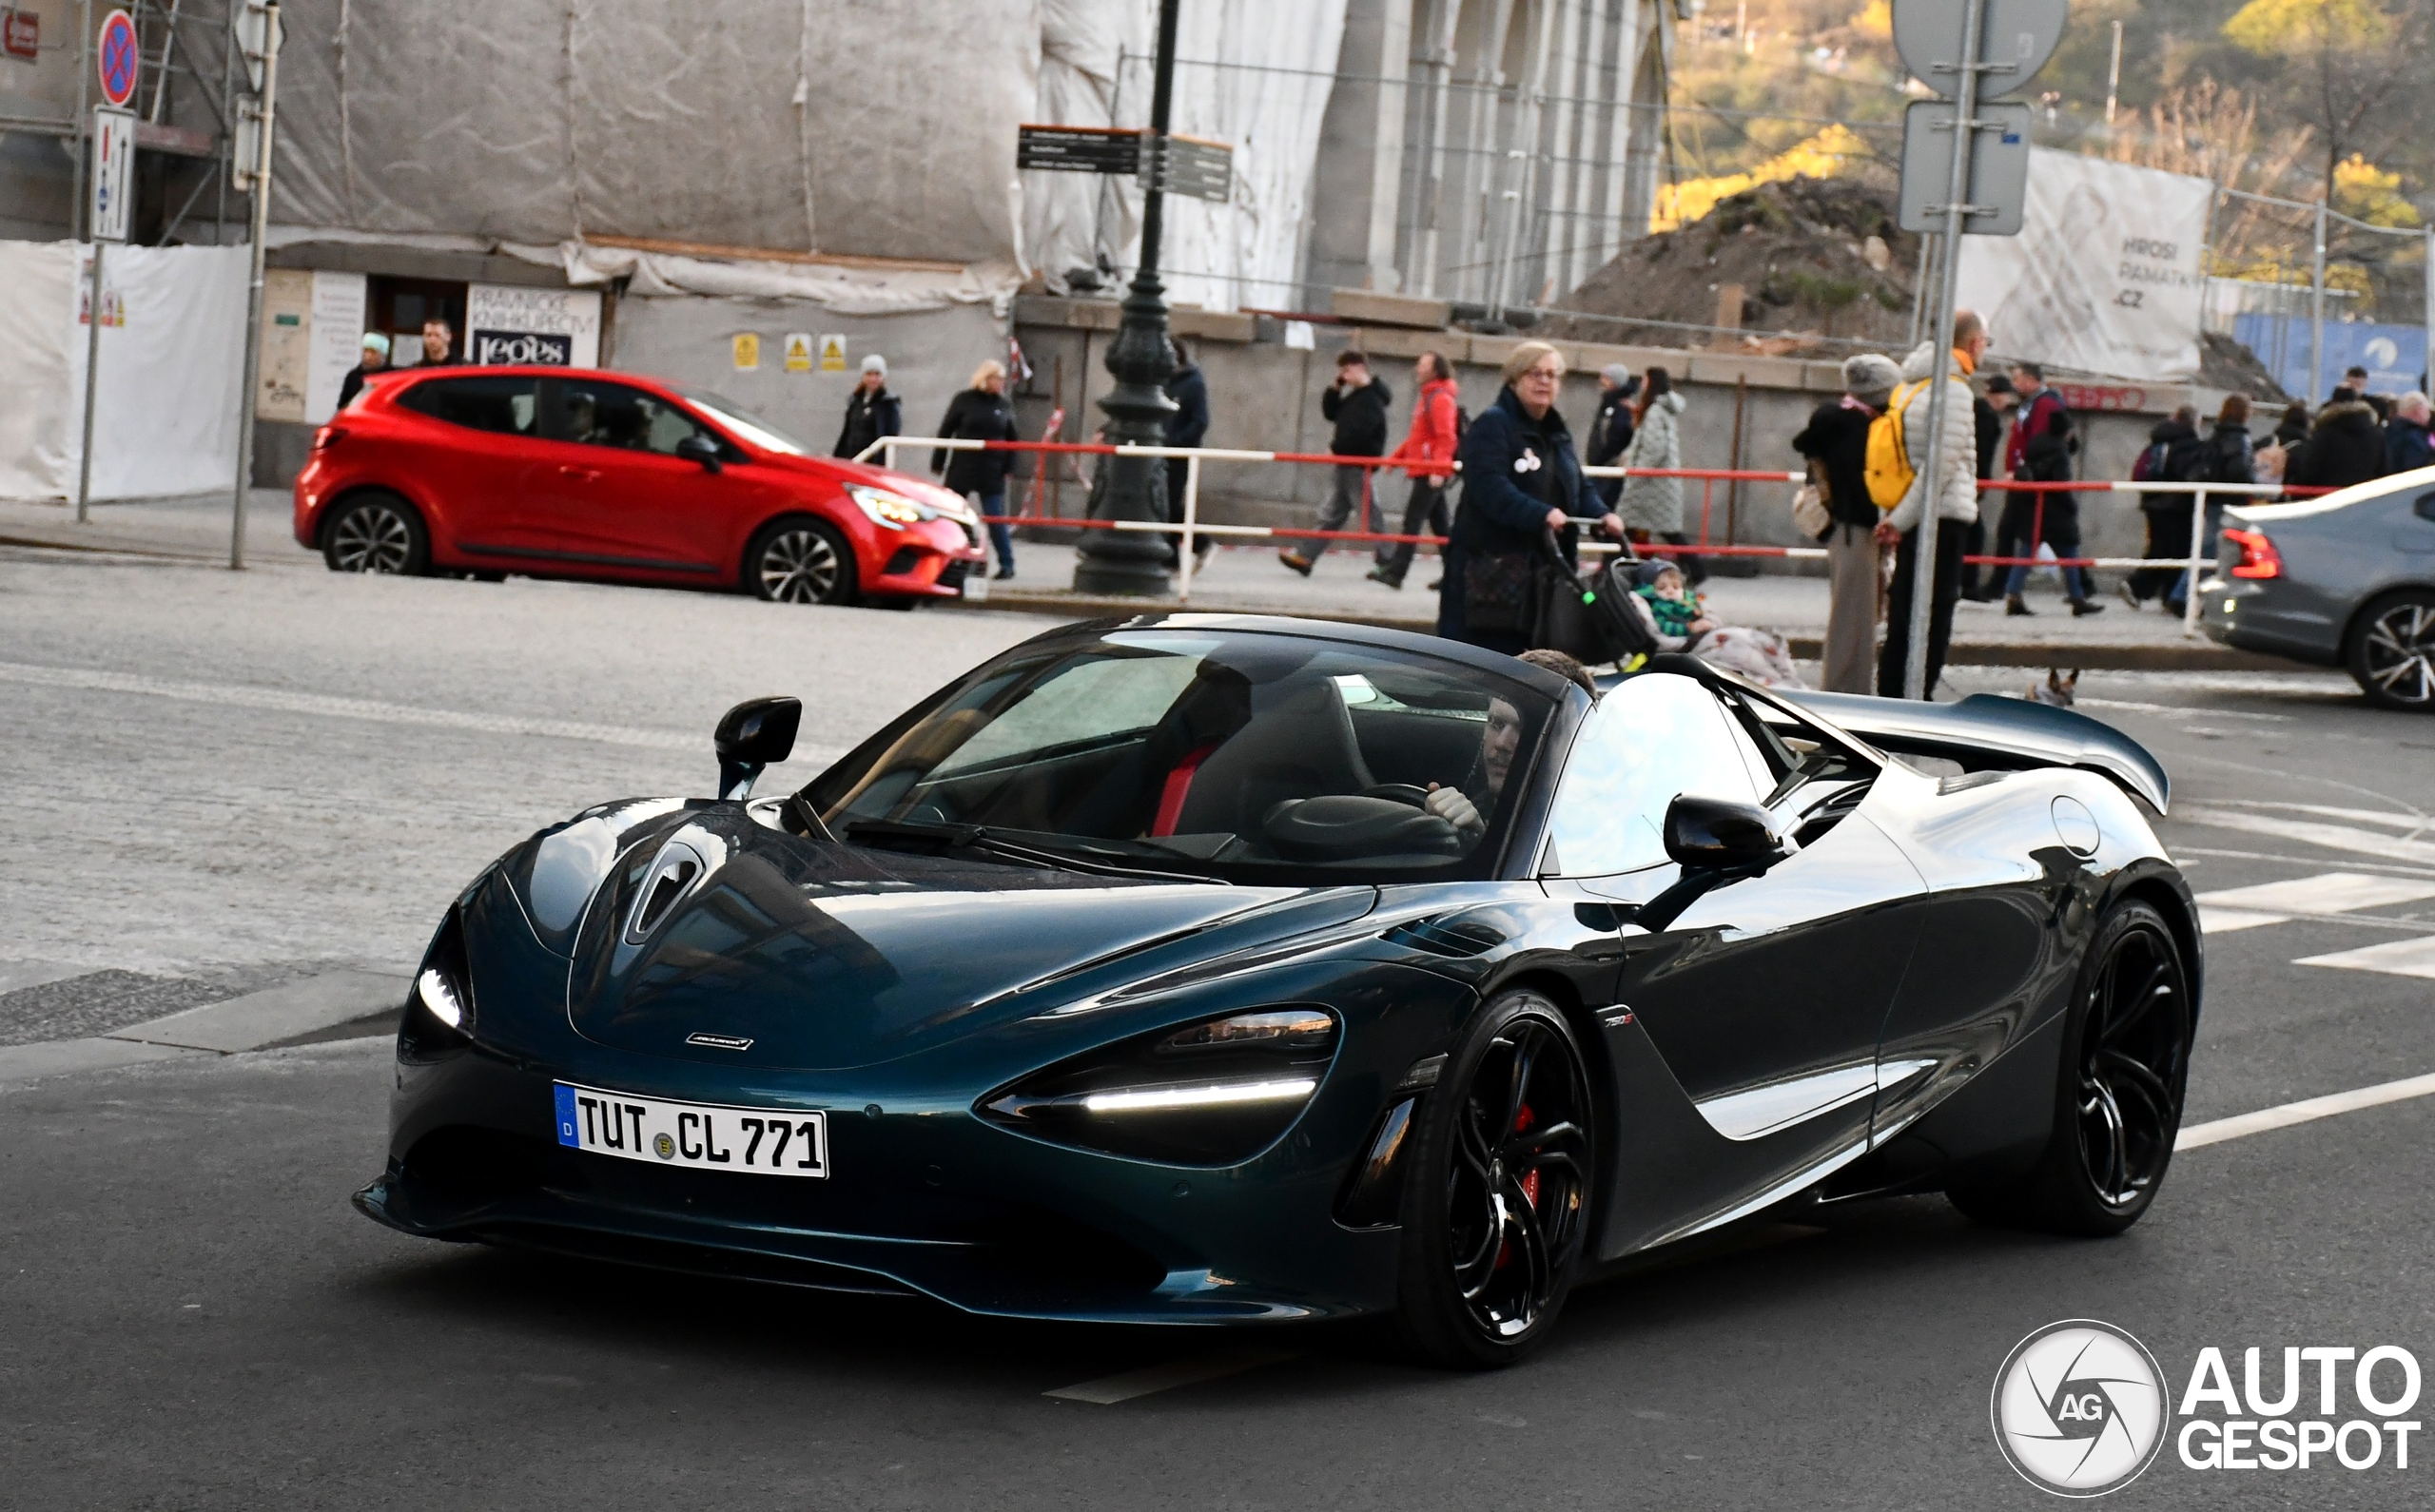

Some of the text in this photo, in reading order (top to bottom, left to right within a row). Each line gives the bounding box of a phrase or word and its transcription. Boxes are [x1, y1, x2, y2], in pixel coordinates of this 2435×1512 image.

[1605, 1013, 1634, 1027] 750S
[563, 1122, 573, 1136] D
[578, 1095, 822, 1170] TUT CL 771
